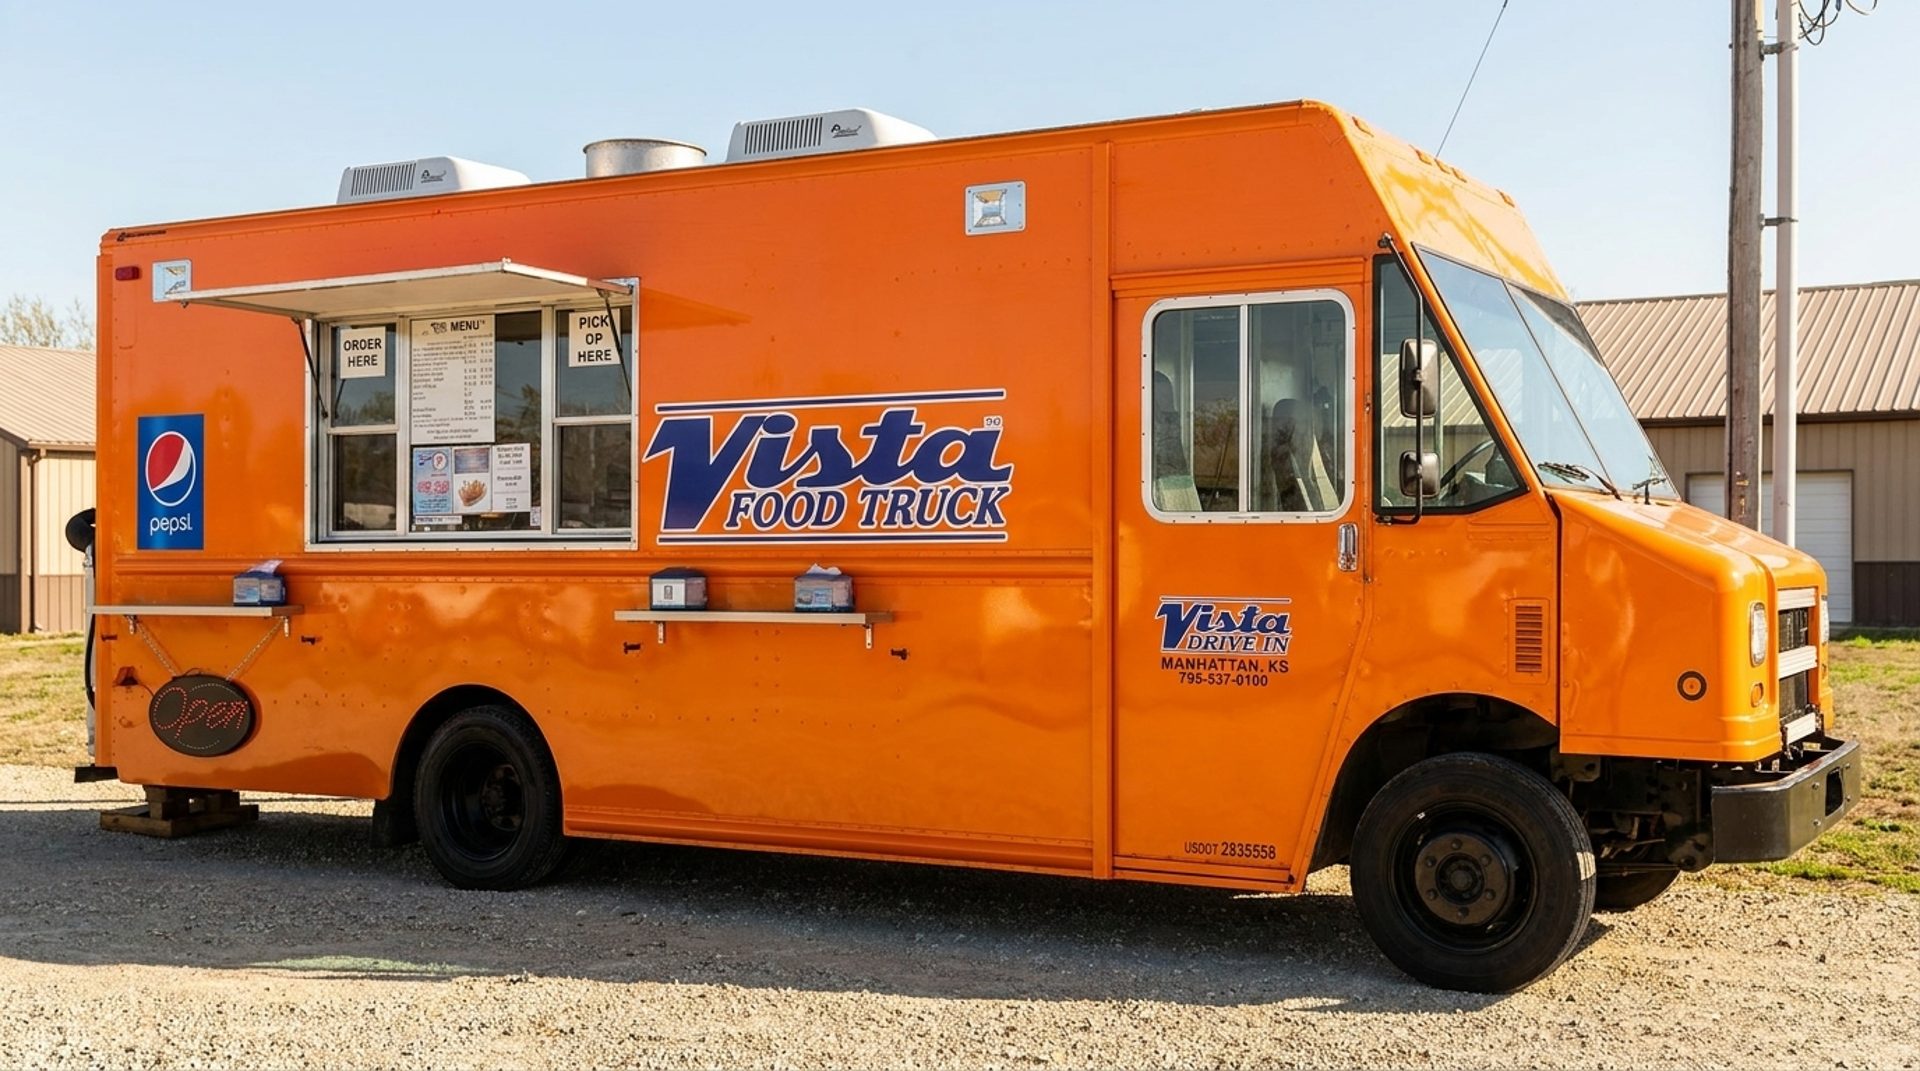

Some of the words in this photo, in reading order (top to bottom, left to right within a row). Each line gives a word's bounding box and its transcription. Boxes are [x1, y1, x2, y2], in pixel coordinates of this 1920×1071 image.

[450, 320, 480, 332] MENU
[579, 315, 609, 329] PICK
[585, 333, 603, 345] OP
[348, 354, 378, 367] HERE
[578, 350, 611, 362] HERE
[641, 408, 1013, 531] Vista
[724, 490, 848, 530] FOOD
[858, 483, 1011, 529] TRUCK
[1156, 602, 1291, 649] Vista
[1187, 635, 1257, 651] DRIVE
[1263, 636, 1290, 652] IN
[1268, 660, 1289, 673] KS
[1179, 672, 1268, 687] 795-537-0100
[153, 686, 248, 739] Open
[1221, 842, 1276, 860] 2835558
